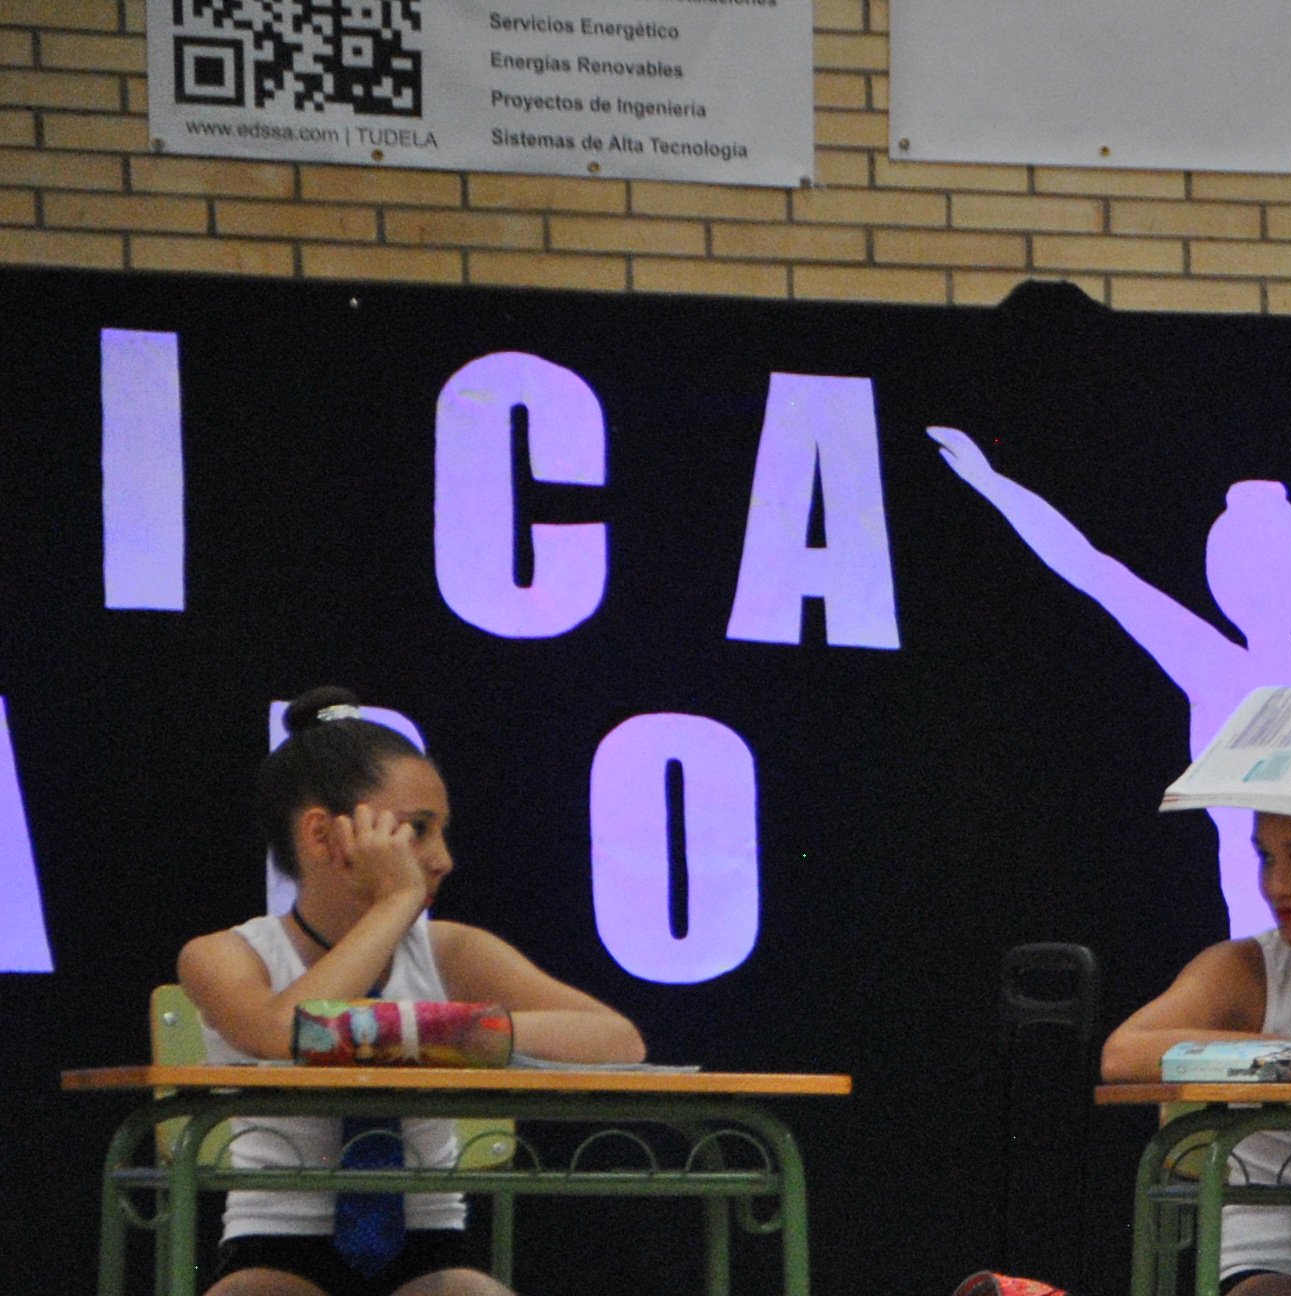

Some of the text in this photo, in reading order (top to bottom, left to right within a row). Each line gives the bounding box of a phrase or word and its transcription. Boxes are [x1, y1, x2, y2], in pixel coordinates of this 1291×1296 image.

[489, 12, 680, 41] Servicios Energético
[577, 56, 684, 79] Renovables
[491, 89, 584, 113] Proyectos
[590, 97, 611, 113] de
[355, 126, 438, 148] TUDELA
[491, 128, 575, 150] Sistemas
[580, 133, 602, 150] de
[607, 134, 644, 153] Alta
